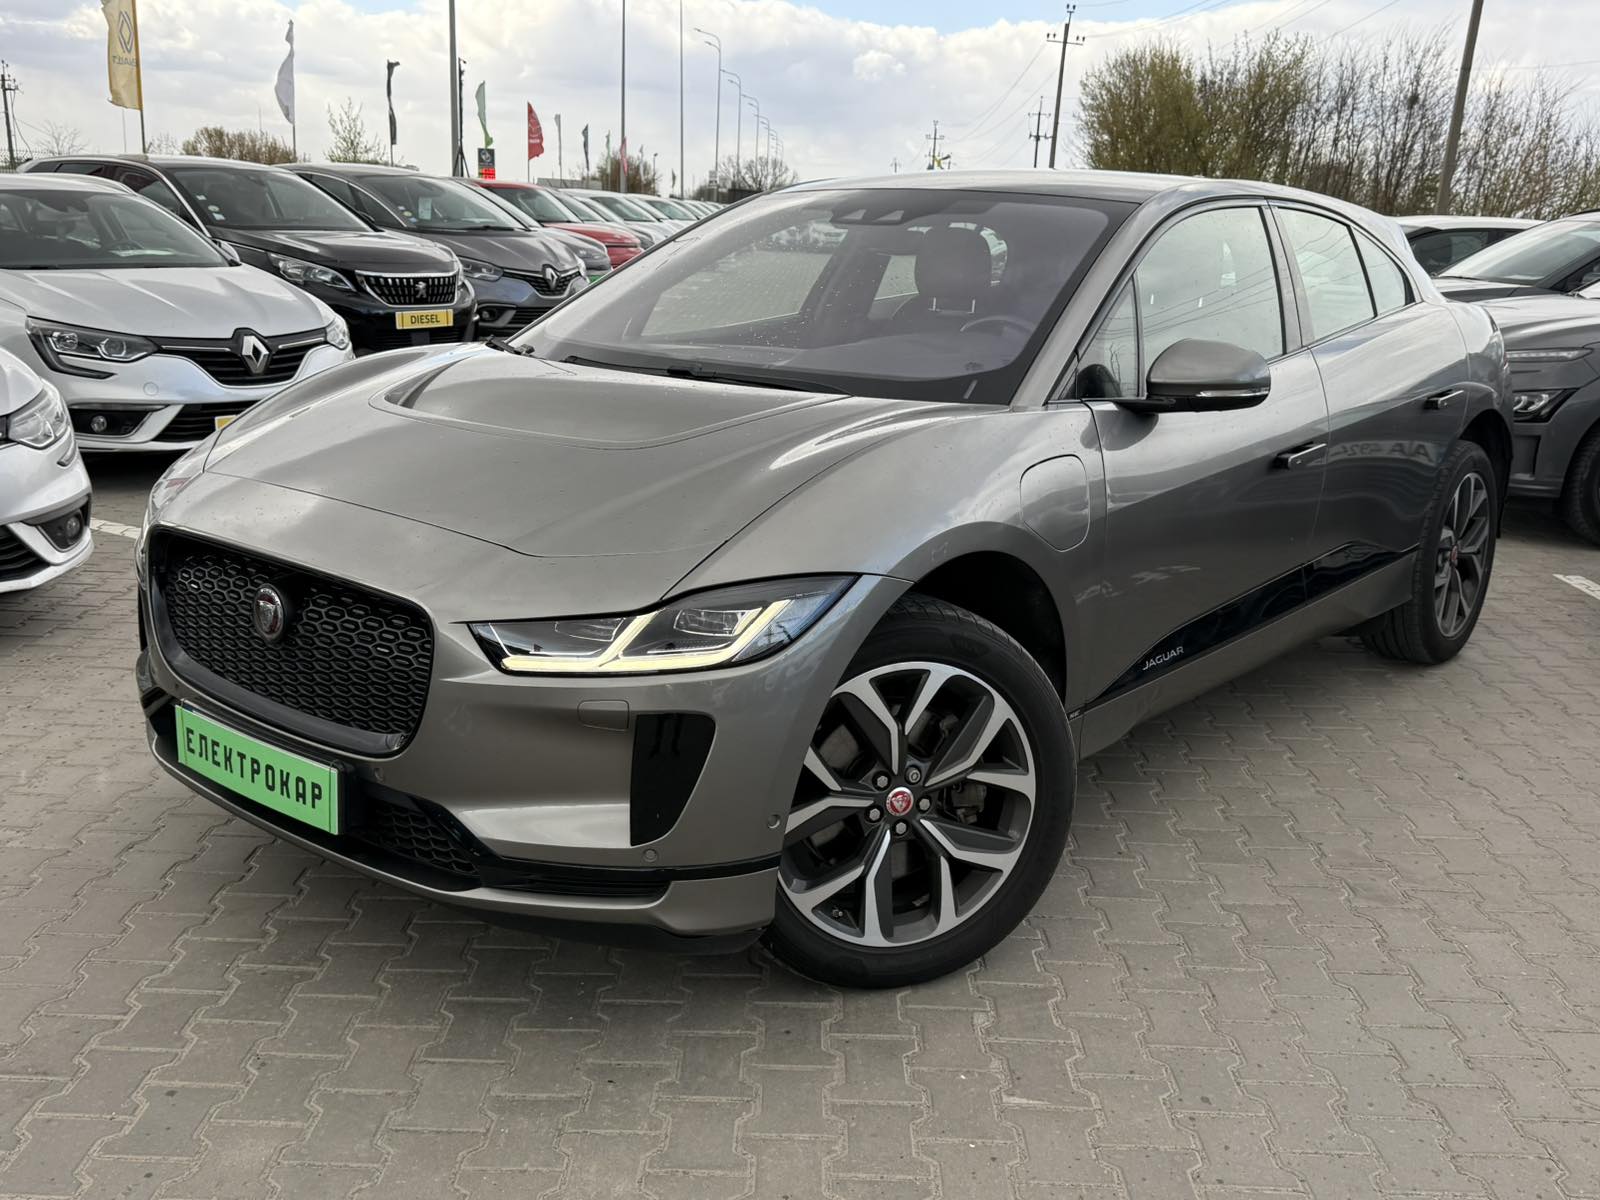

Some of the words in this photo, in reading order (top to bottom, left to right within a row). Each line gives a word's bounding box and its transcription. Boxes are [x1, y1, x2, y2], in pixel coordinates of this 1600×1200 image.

[410, 314, 441, 325] DIESEL
[1142, 646, 1184, 671] JAGUAR
[185, 727, 323, 809] ЕЛЕКТРОКАР
